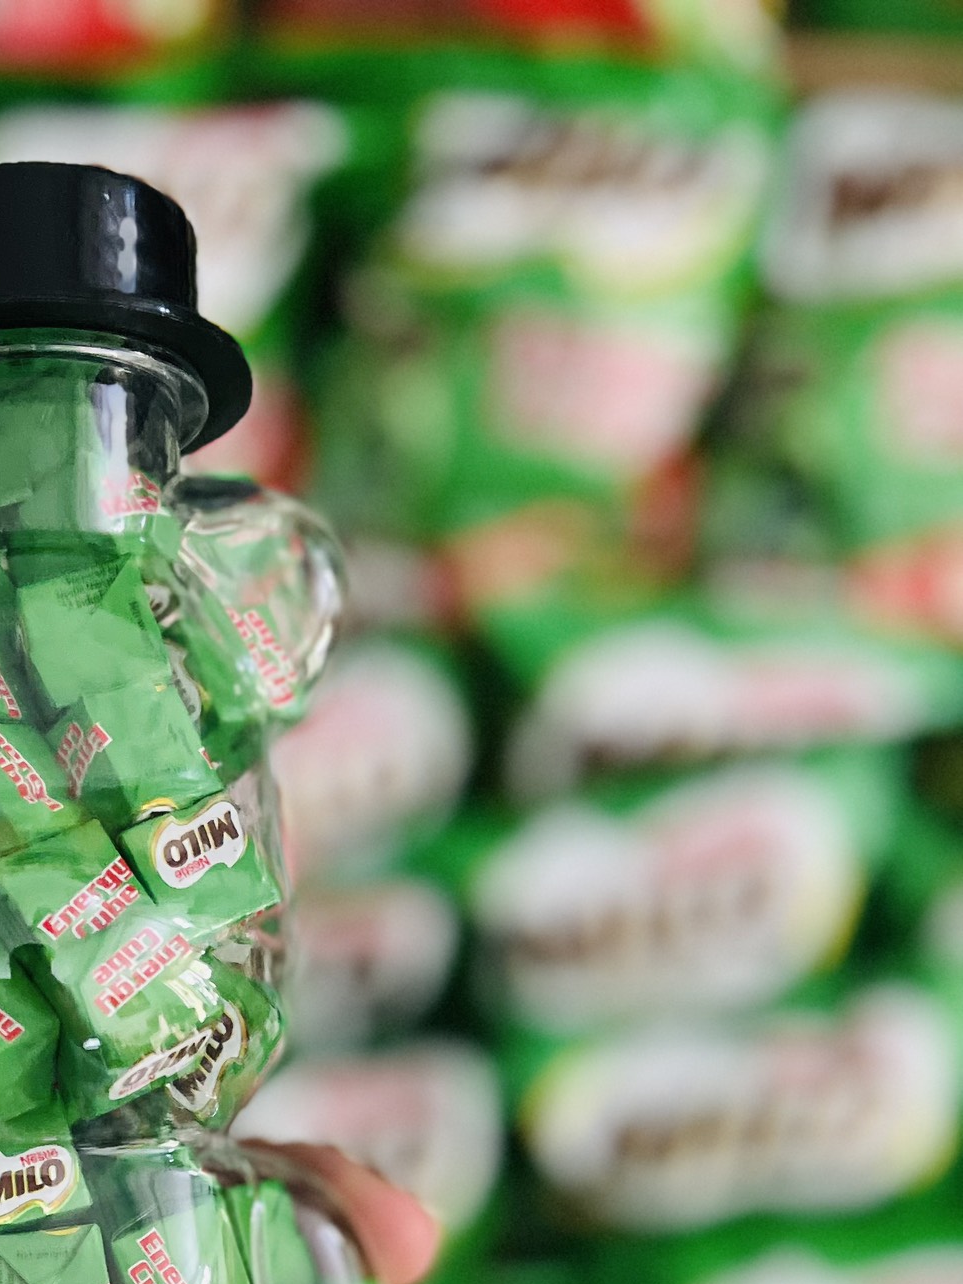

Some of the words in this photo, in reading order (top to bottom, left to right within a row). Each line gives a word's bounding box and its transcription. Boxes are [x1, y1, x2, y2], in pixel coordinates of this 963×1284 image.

[163, 811, 239, 869] MILO
[37, 856, 134, 941] Energy
[71, 883, 141, 940] Cube
[92, 927, 164, 986] Cube
[94, 933, 193, 1017] Energy
